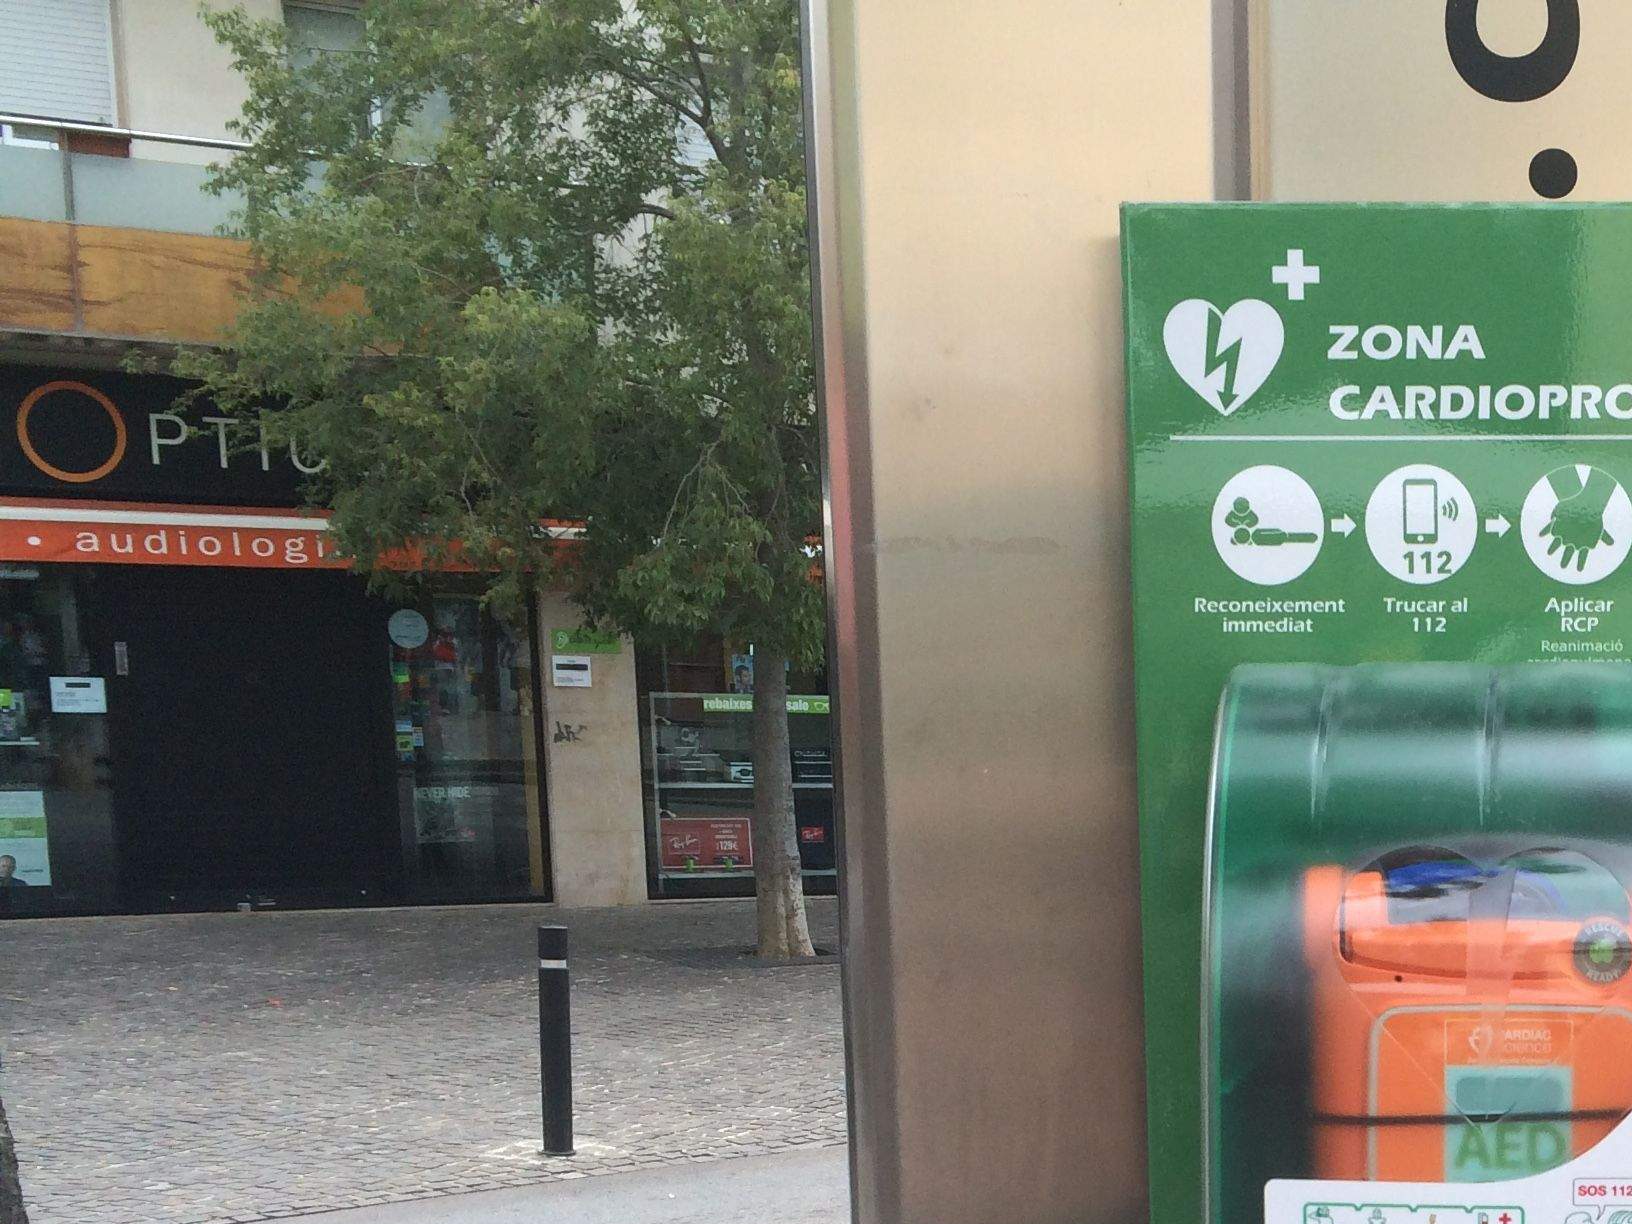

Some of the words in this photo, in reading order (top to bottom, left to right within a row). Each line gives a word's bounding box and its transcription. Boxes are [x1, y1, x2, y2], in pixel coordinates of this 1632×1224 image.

[1327, 323, 1487, 360] ZONA
[1403, 551, 1453, 575] 112
[1194, 597, 1346, 614] Reconeixement
[1383, 597, 1446, 614] Trucar
[1450, 597, 1469, 614] al
[1544, 596, 1615, 617] Aplicar
[1222, 617, 1314, 634] immediat
[1412, 617, 1447, 634] 112
[1560, 615, 1600, 633] RCP
[1540, 637, 1624, 654] Reanimació
[1454, 1122, 1566, 1170] AED
[1578, 1185, 1607, 1198] SOS
